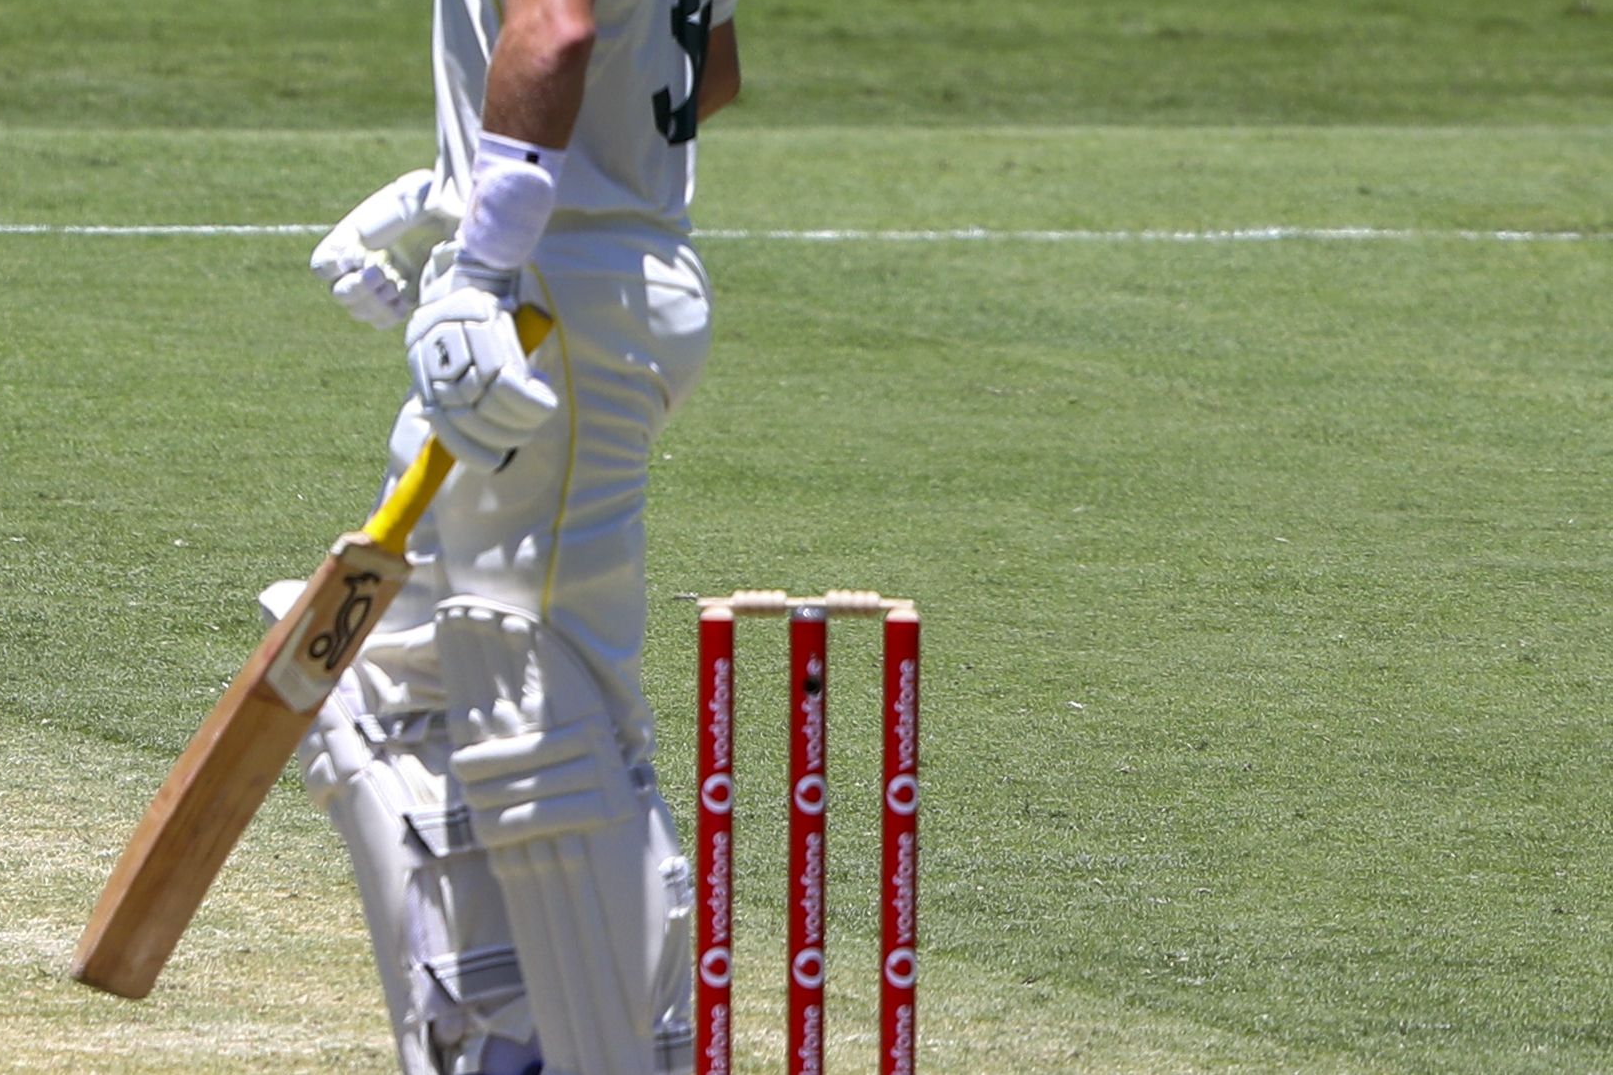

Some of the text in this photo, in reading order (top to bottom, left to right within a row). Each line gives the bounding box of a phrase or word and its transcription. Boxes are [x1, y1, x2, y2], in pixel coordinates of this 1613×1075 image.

[708, 657, 729, 770] vodafone
[801, 658, 823, 771] vodafoe
[894, 658, 916, 771] vodafone
[706, 830, 728, 944] vodafone
[799, 831, 821, 945] vodafone
[892, 831, 914, 945] vodafone
[705, 1003, 728, 1075] afone
[798, 1004, 820, 1075] afone
[890, 1004, 913, 1075] afone
